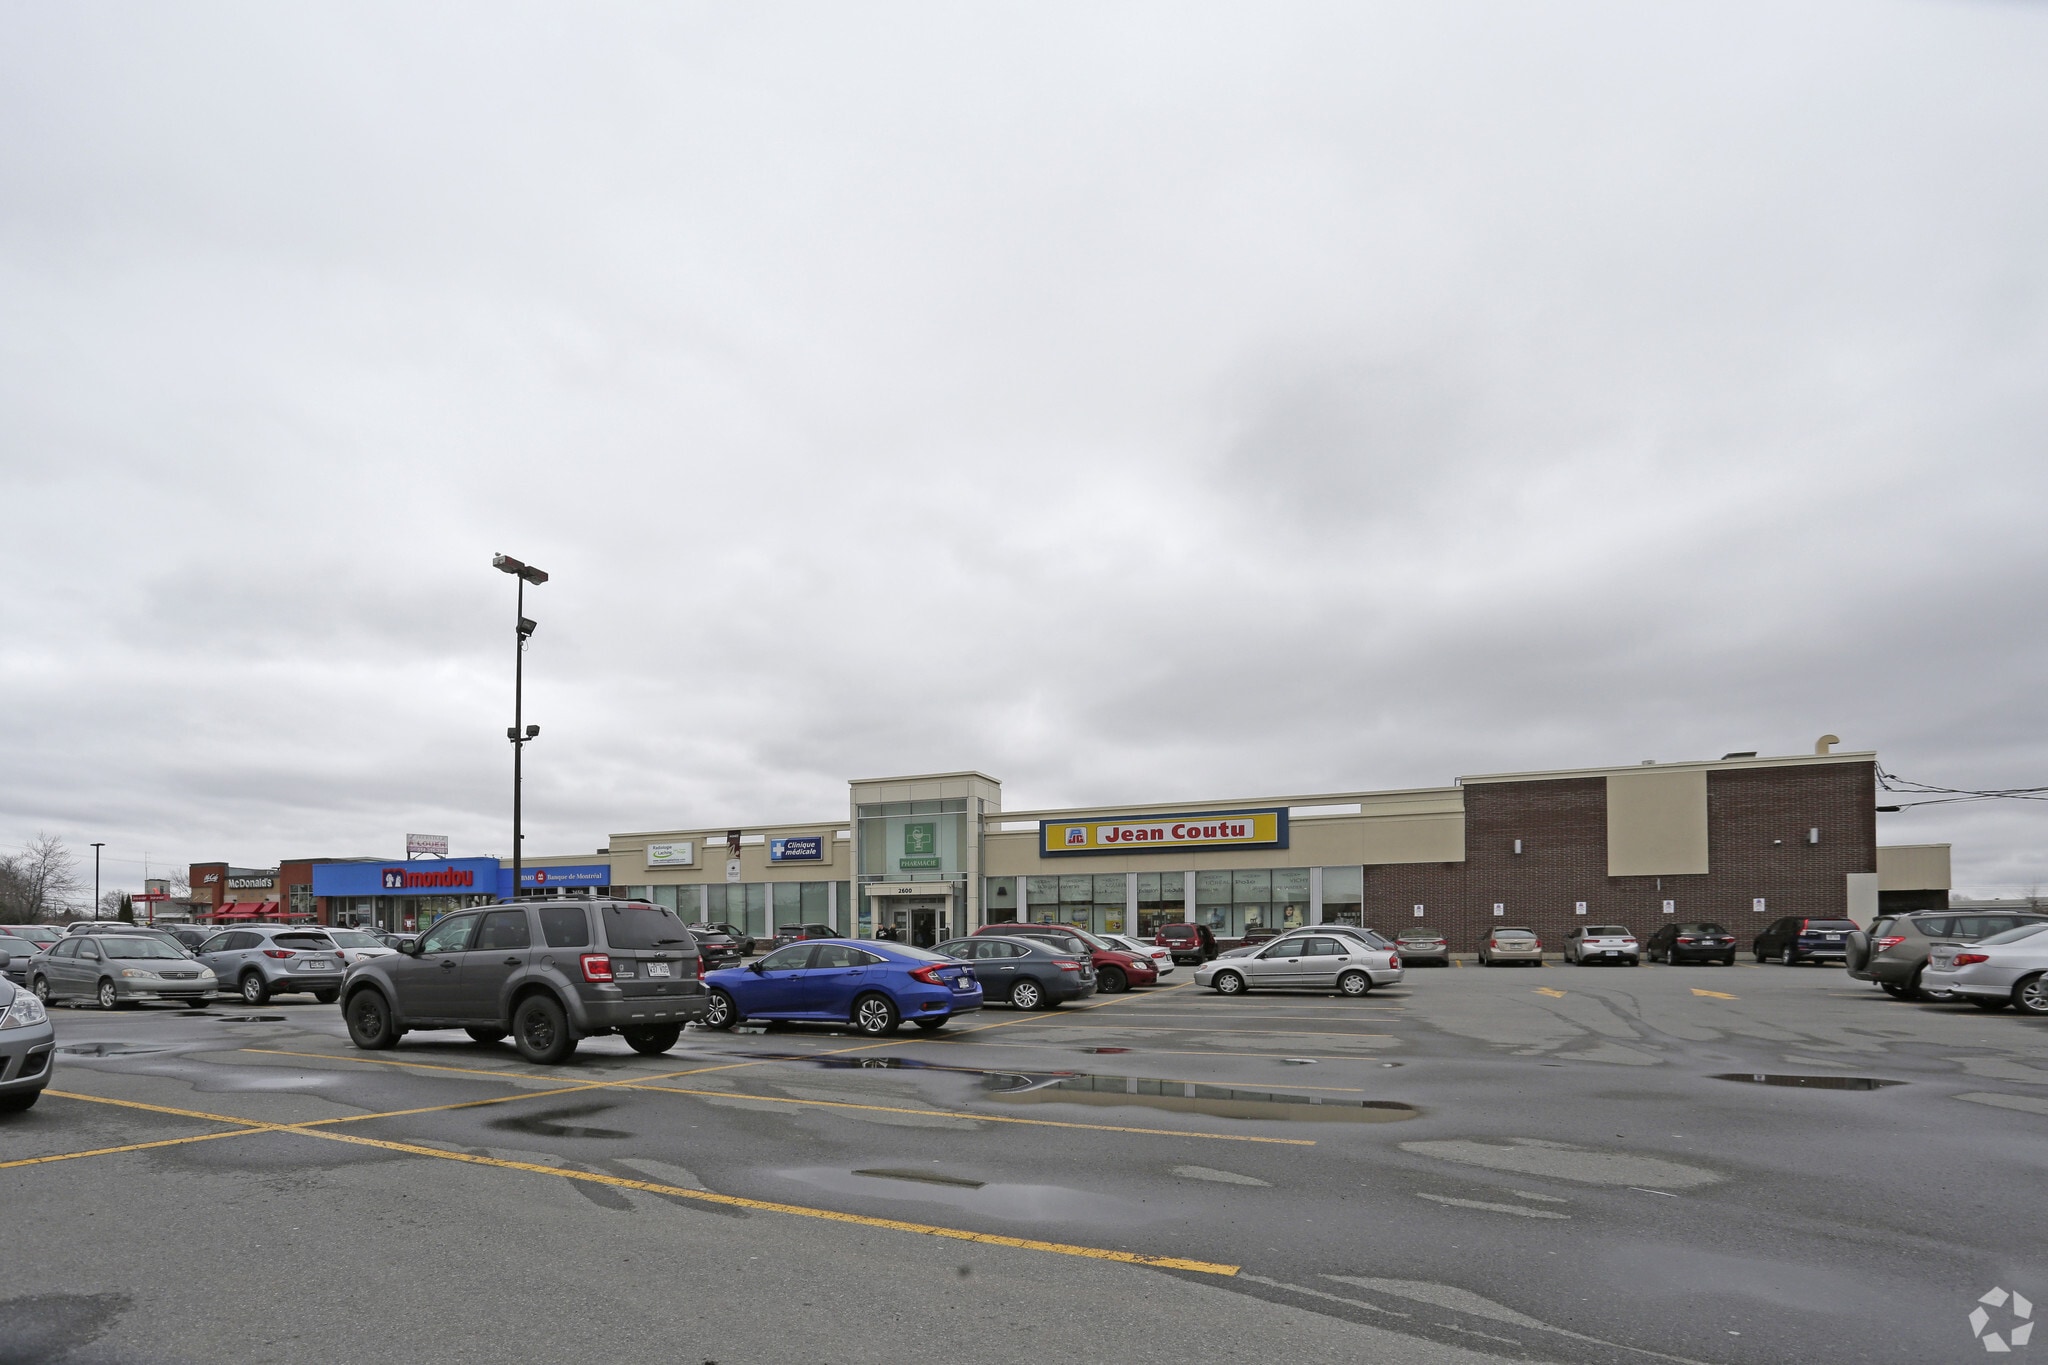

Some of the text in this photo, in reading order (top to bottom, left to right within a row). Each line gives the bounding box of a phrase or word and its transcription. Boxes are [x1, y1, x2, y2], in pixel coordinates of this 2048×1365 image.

[1105, 821, 1245, 843] Jean Coutu
[417, 840, 446, 848] LOUER
[787, 841, 816, 849] Clinique
[785, 847, 817, 855] médicale
[407, 866, 473, 887] mondou
[228, 877, 272, 889] McDonald's
